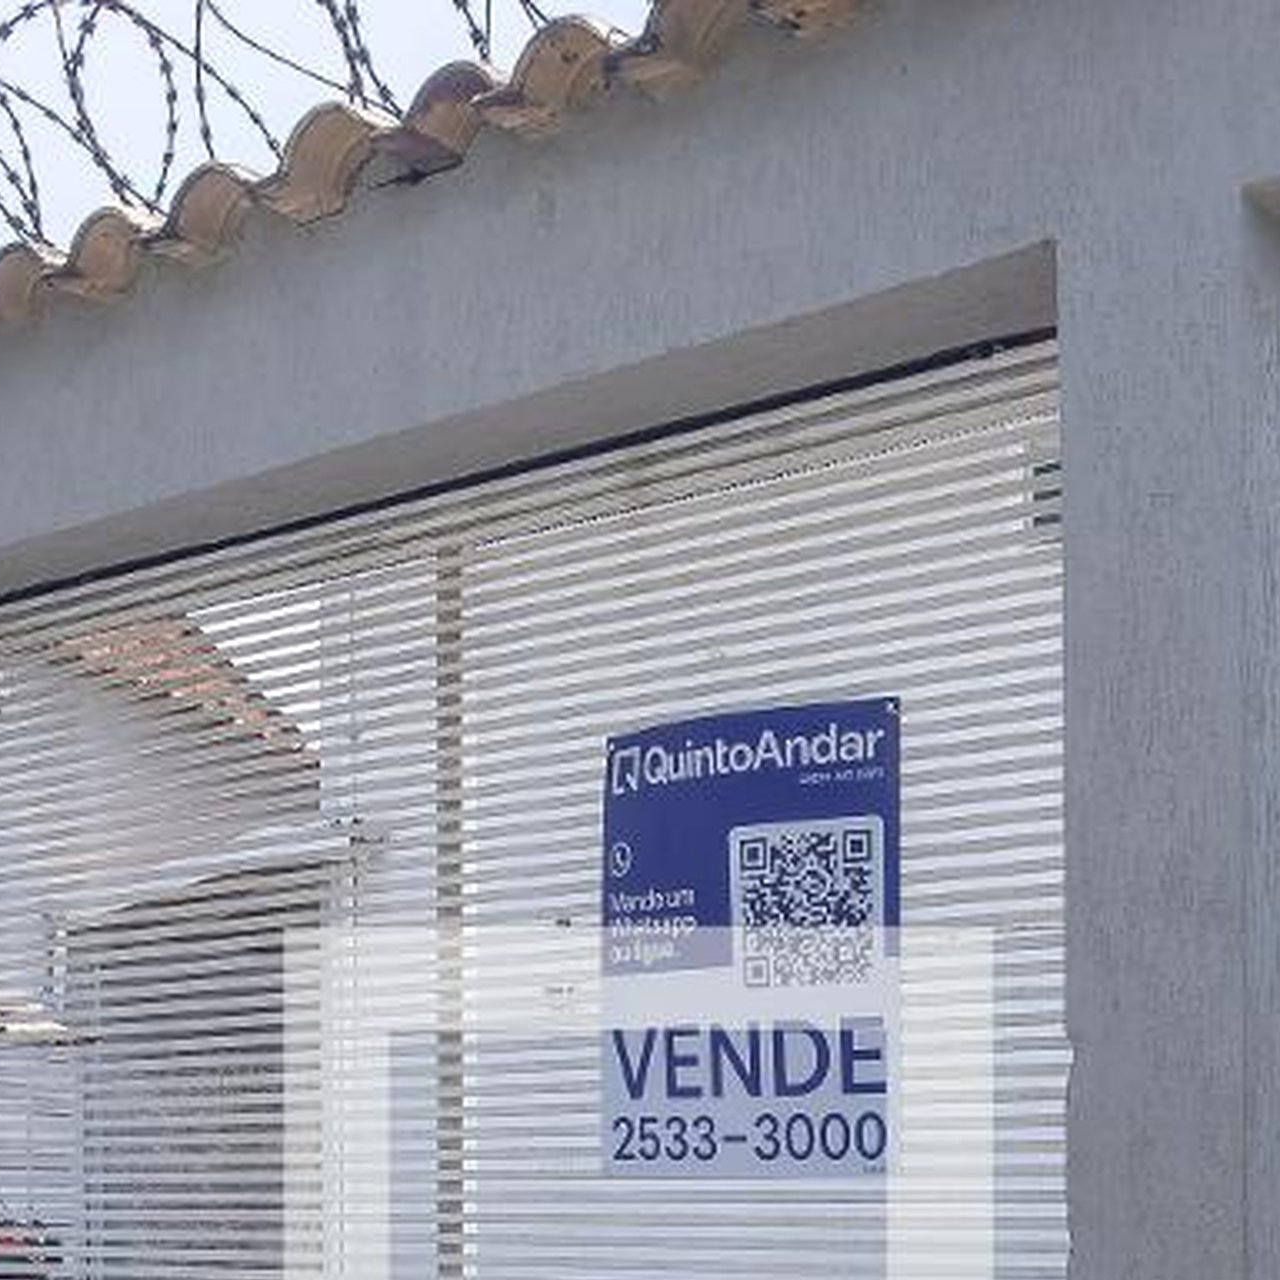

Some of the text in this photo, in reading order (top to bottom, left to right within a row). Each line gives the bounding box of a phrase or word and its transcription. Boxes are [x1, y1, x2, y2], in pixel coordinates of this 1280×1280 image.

[643, 722, 885, 786] QuintoAndar
[612, 1016, 888, 1100] VENDE
[612, 1112, 887, 1161] 2533-3000
